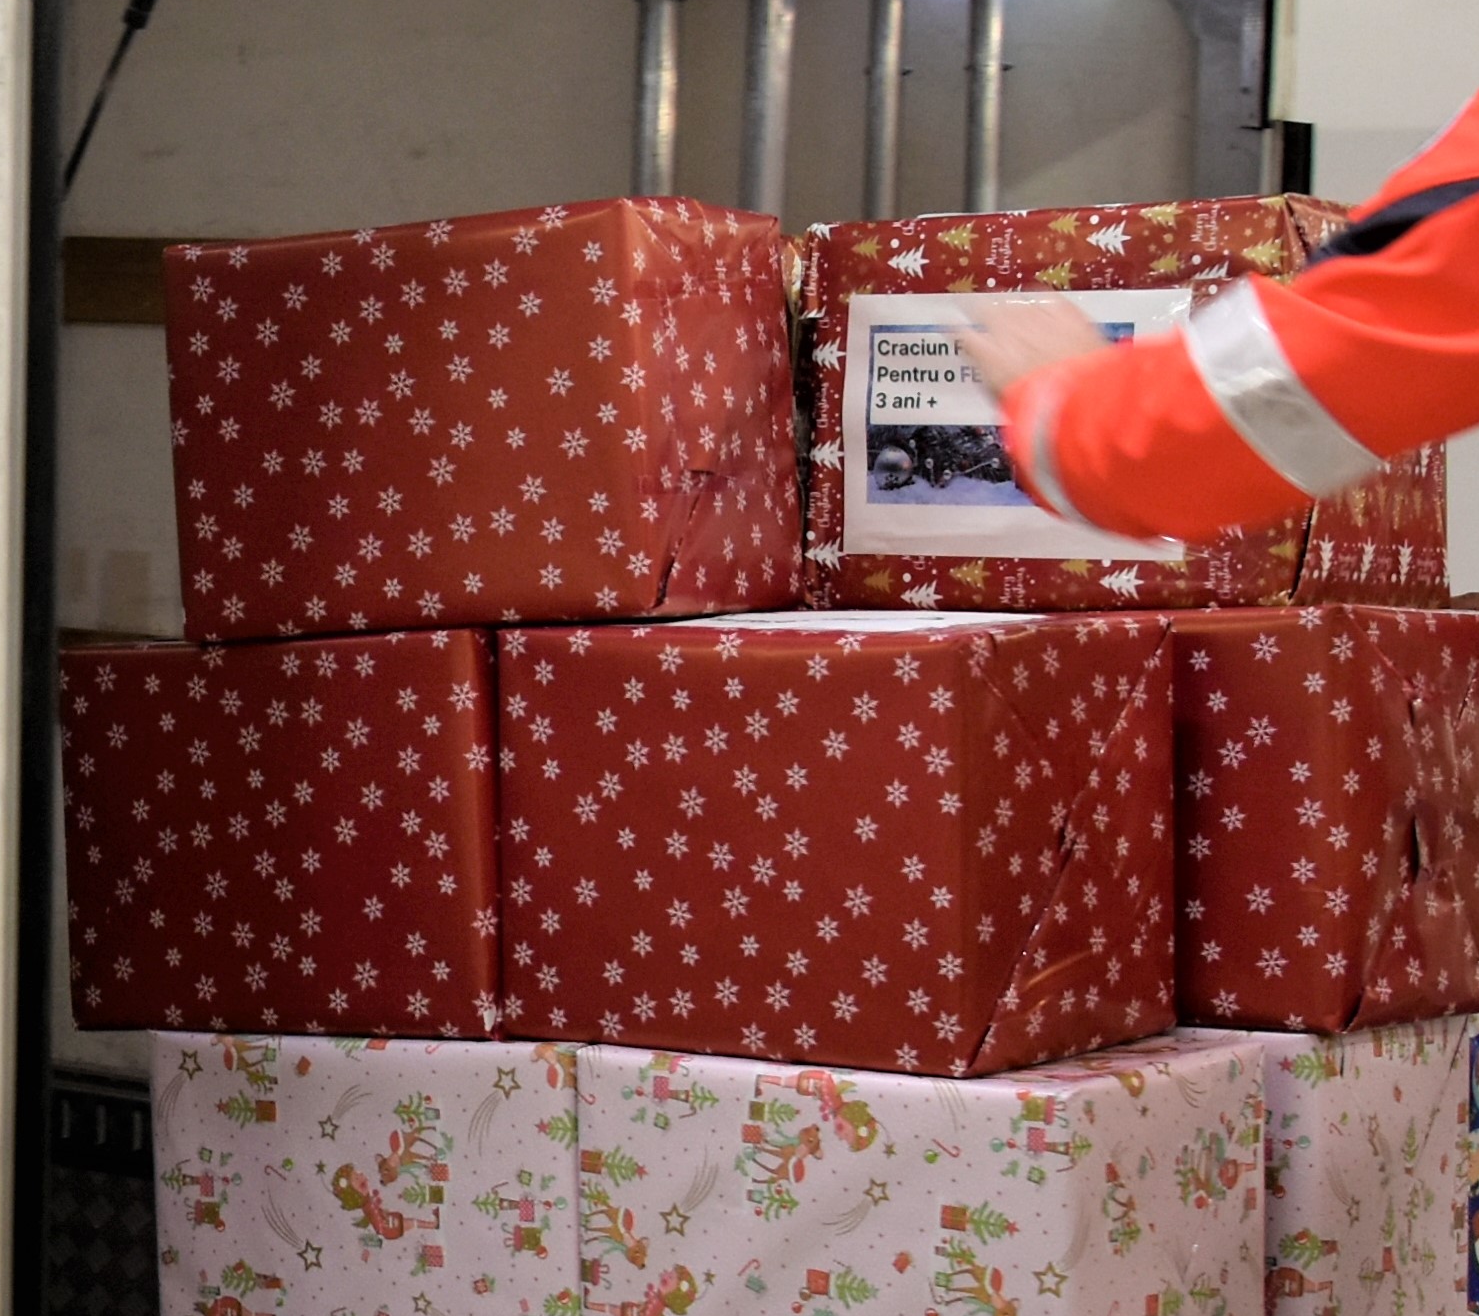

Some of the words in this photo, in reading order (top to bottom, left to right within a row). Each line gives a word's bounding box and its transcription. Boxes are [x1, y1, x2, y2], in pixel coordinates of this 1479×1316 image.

[985, 237, 1003, 265] Merry
[877, 338, 949, 356] Craciun
[877, 365, 939, 383] Pentru
[943, 369, 955, 383] o
[875, 392, 887, 409] 3
[892, 392, 921, 409] ani
